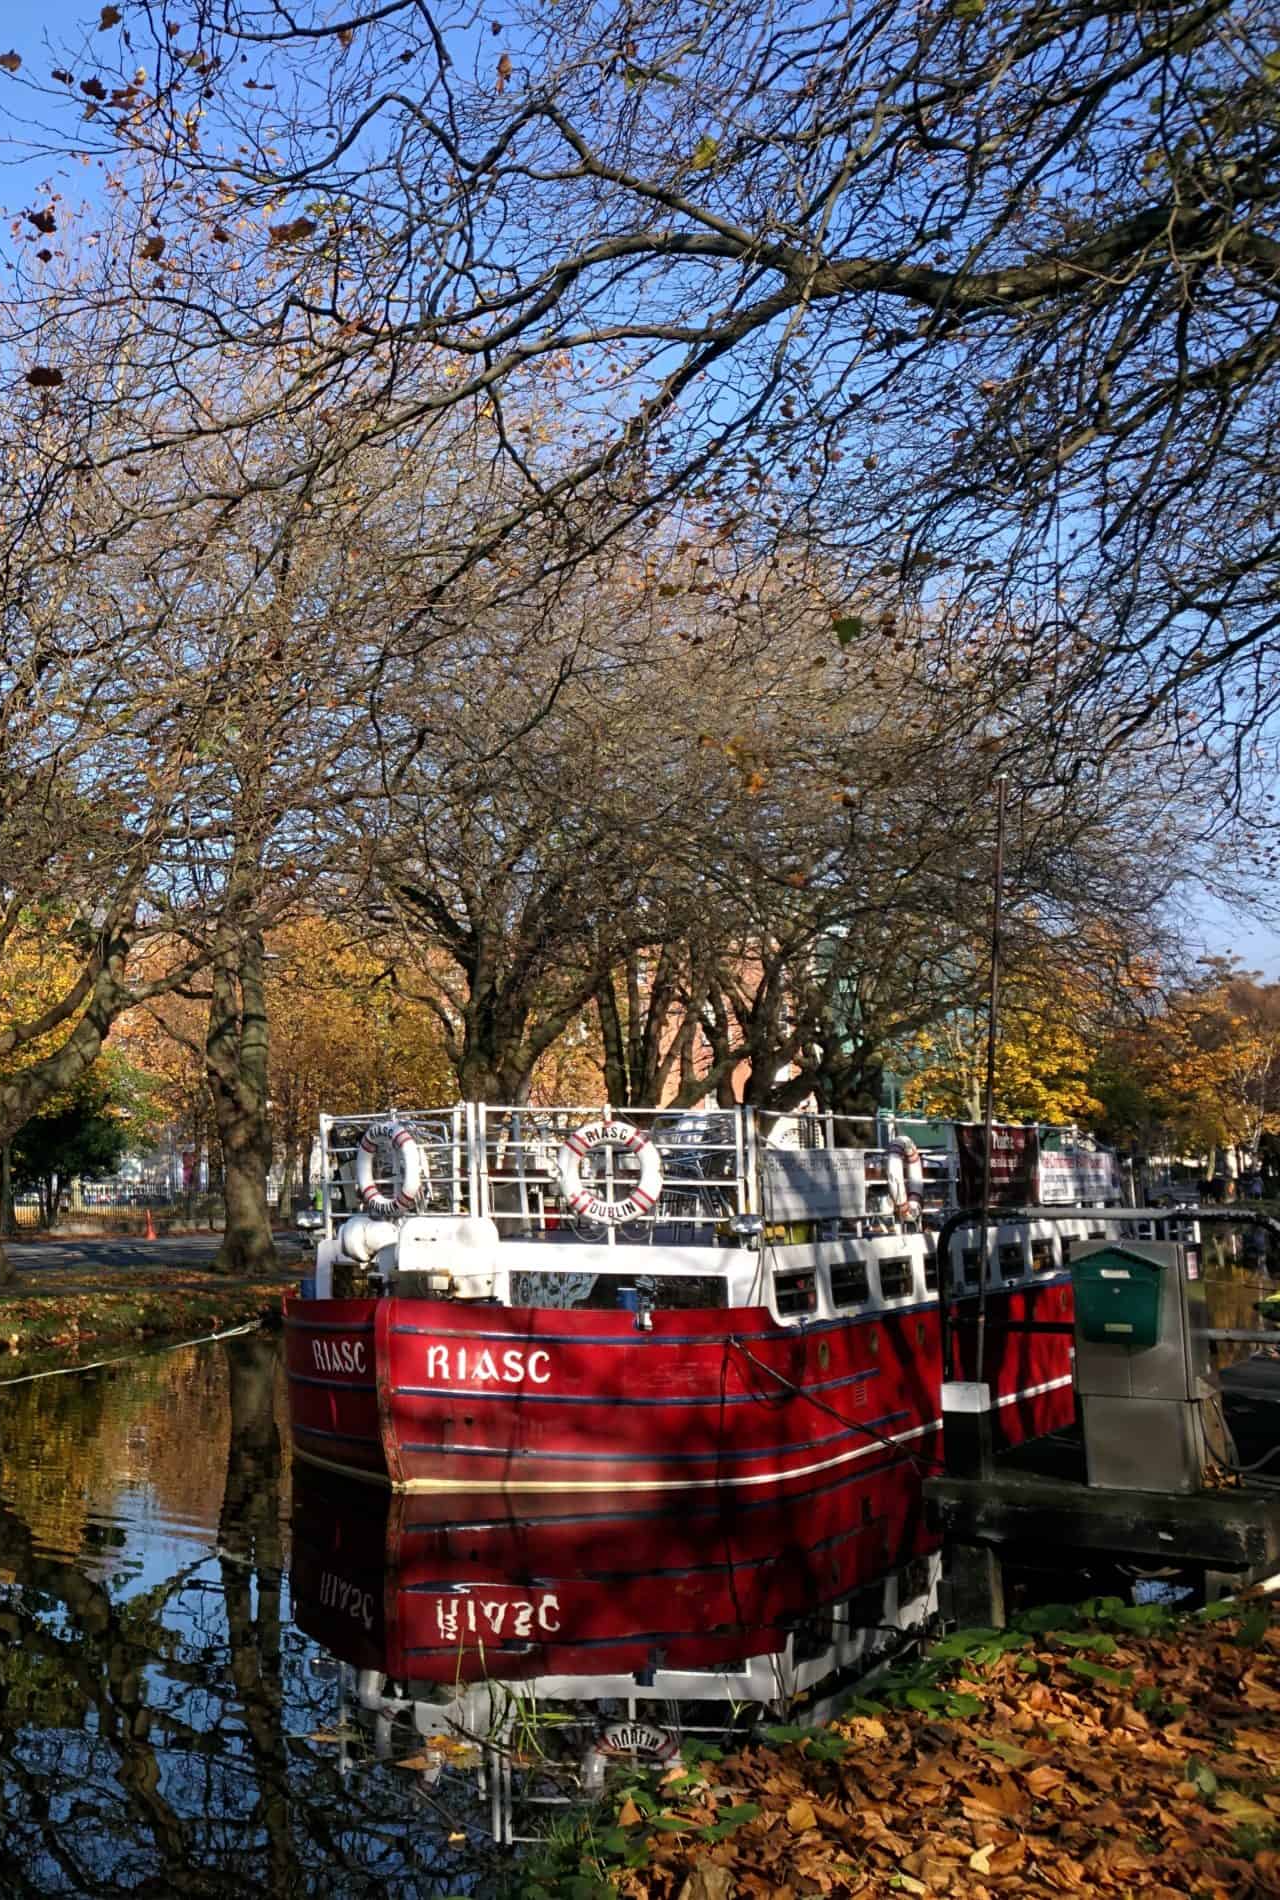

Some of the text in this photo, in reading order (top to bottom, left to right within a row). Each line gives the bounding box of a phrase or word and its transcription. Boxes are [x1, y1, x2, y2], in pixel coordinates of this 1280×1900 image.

[585, 1126, 628, 1142] RIASC
[590, 1201, 637, 1217] DUBLIN
[312, 1339, 367, 1374] RIASC
[427, 1344, 551, 1384] RIASC
